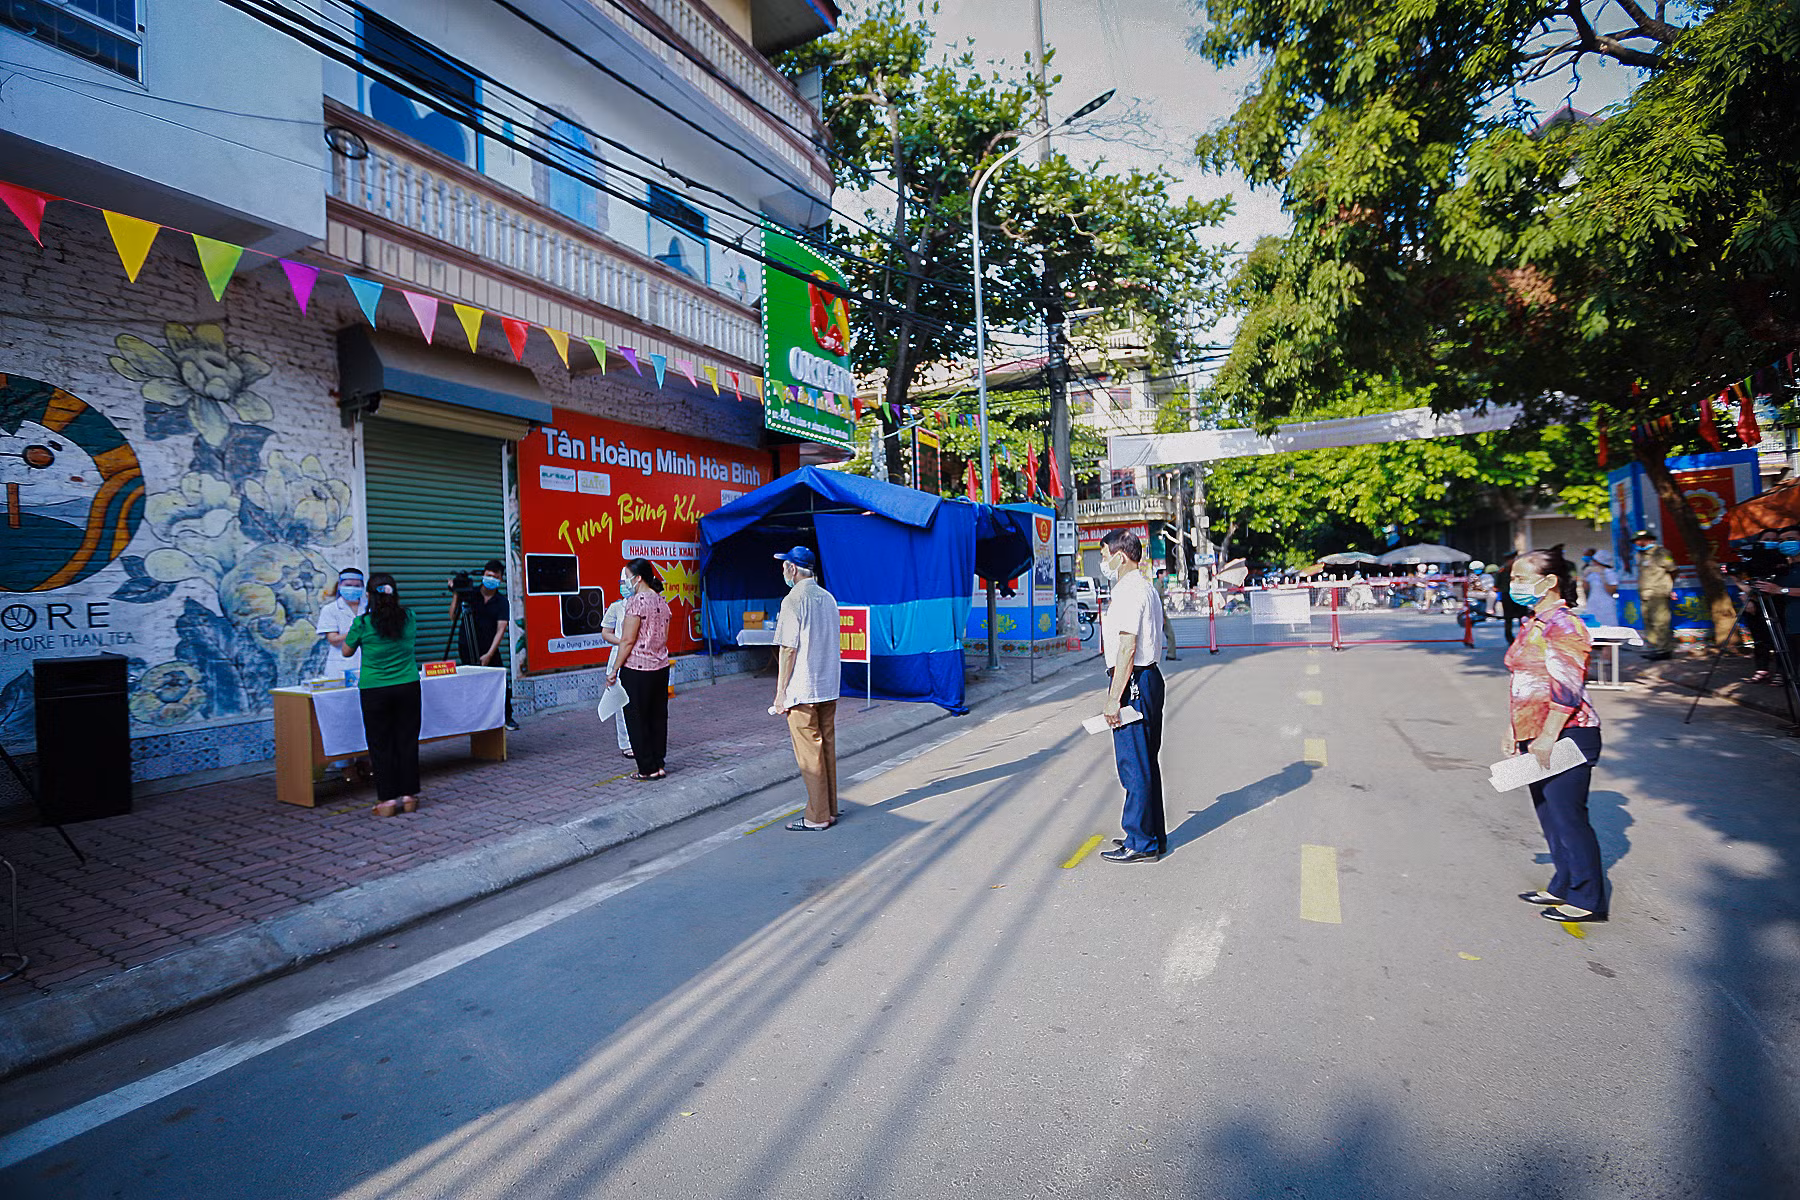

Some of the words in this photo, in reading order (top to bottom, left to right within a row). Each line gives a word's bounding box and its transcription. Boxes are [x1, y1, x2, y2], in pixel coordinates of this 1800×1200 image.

[541, 427, 586, 461] Tân
[590, 436, 652, 476] Hoàng
[656, 448, 697, 477] Minh
[700, 456, 729, 482] Hòa
[731, 462, 761, 486] Bình
[3, 635, 56, 652] MORE
[60, 633, 105, 648] THAN
[108, 631, 138, 645] TEA
